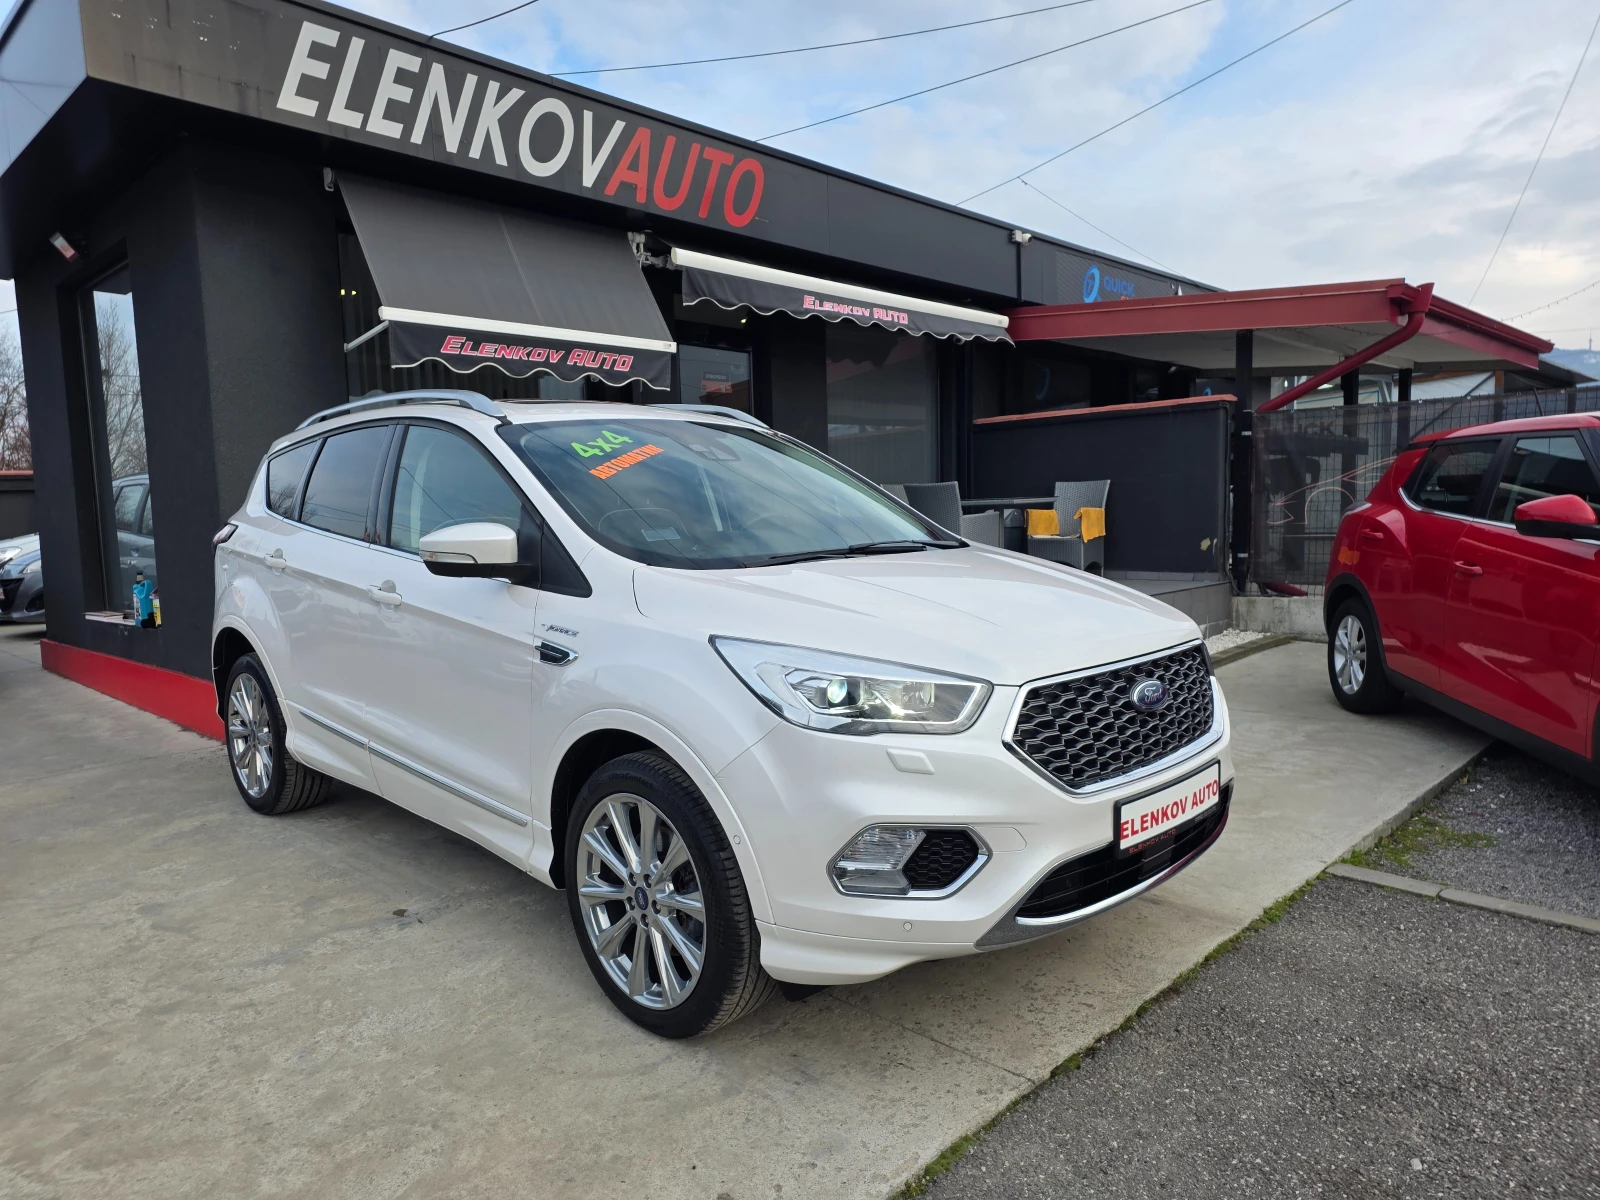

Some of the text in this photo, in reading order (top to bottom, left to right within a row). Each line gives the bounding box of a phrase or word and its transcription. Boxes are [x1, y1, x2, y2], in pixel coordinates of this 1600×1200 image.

[1103, 276, 1135, 297] QUICK
[872, 308, 908, 324] AUTO
[441, 335, 634, 372] ELENKOV AUTO
[1120, 796, 1188, 840] ELENKOV
[1191, 779, 1219, 810] AUTO
